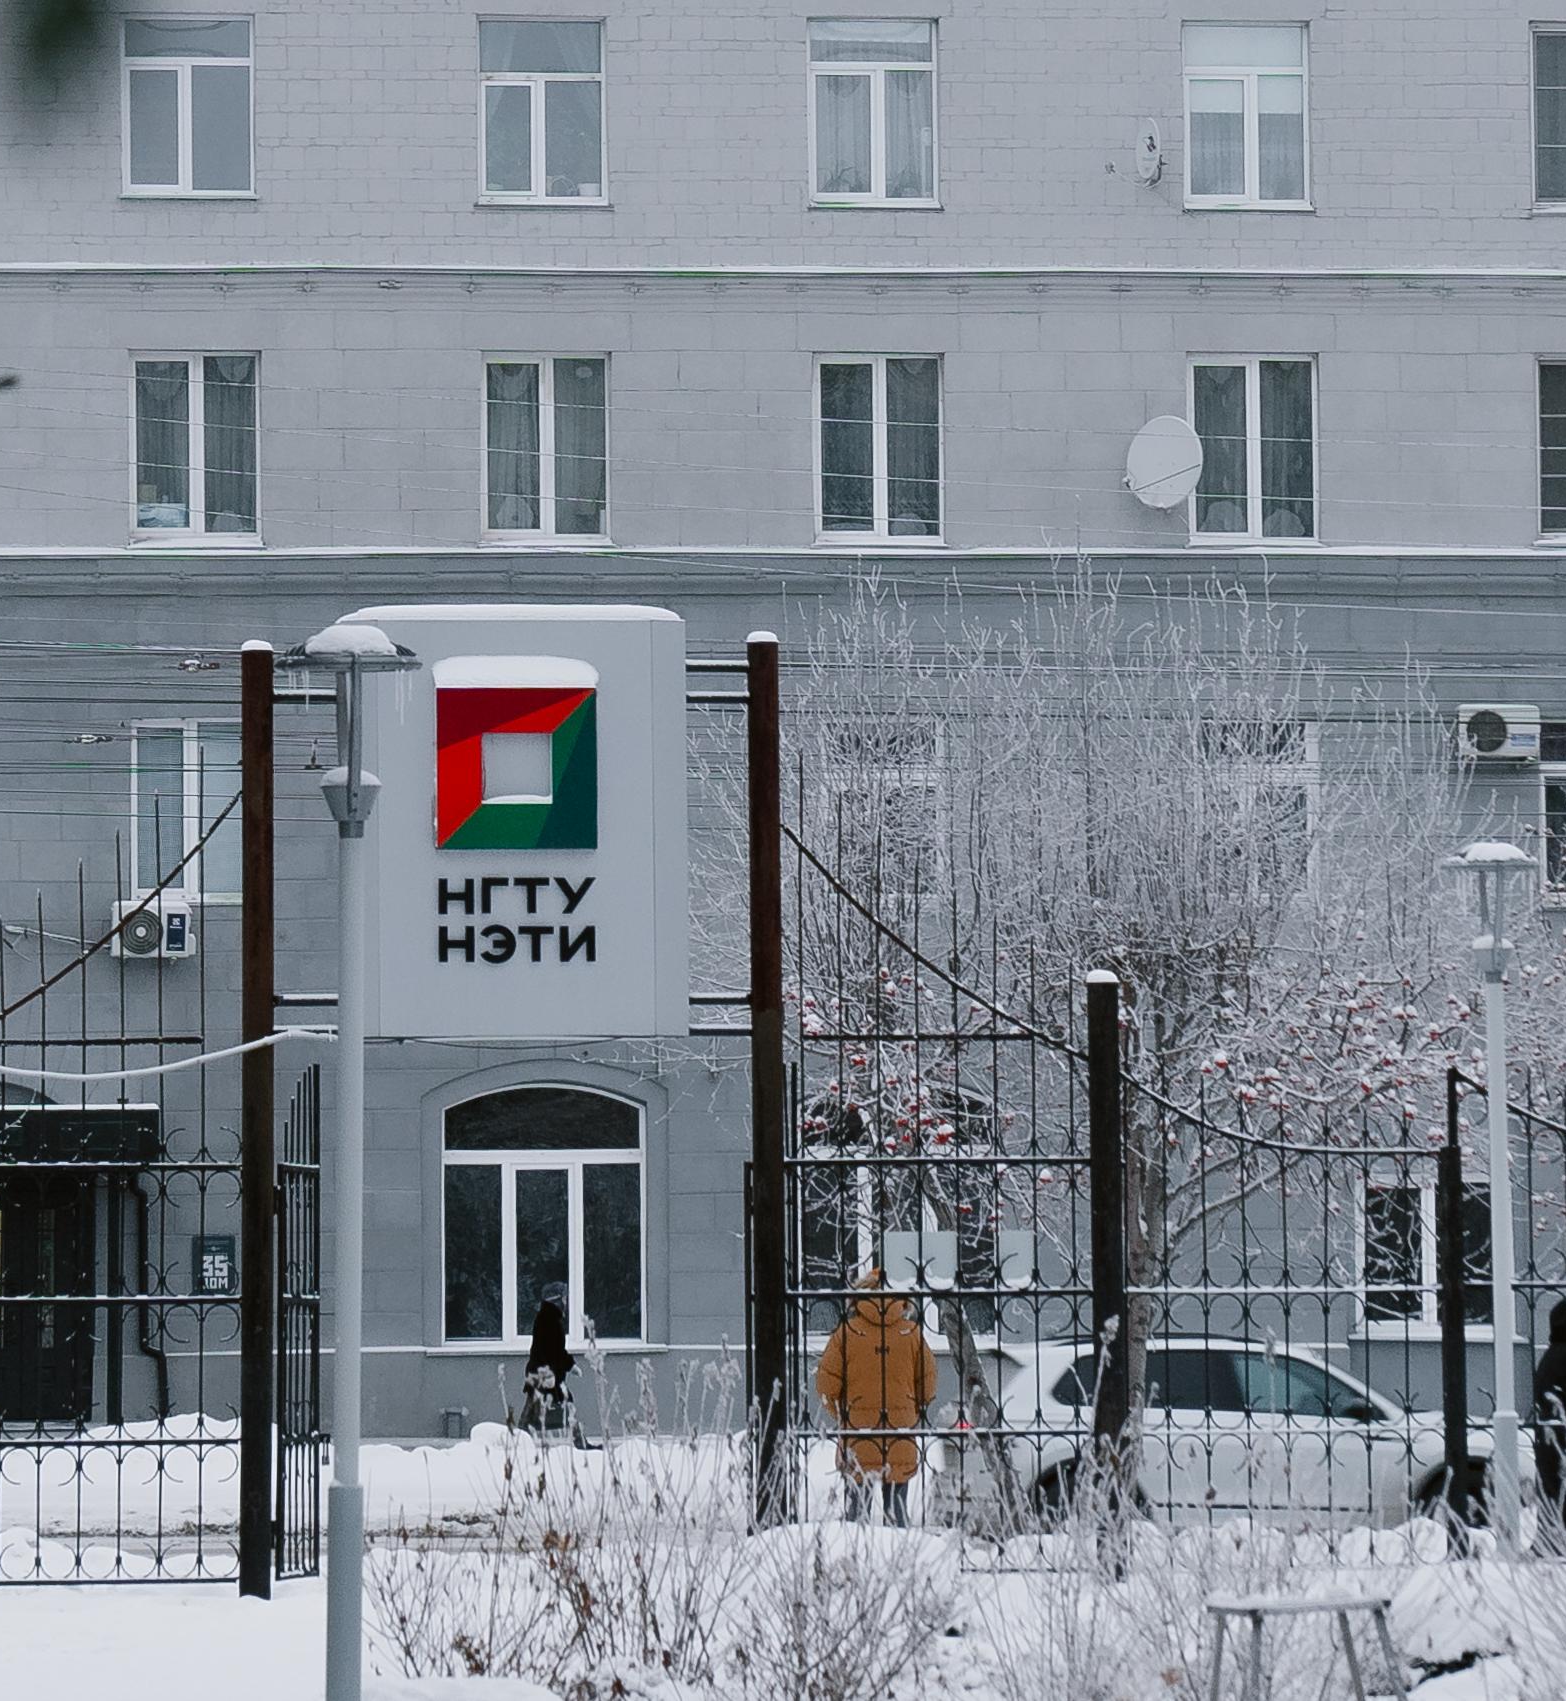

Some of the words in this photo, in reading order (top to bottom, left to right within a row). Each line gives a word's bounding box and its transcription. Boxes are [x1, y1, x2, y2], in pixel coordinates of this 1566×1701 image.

[438, 876, 596, 915] НГТУ
[438, 924, 596, 965] НЭТИ
[202, 1255, 228, 1277] 35
